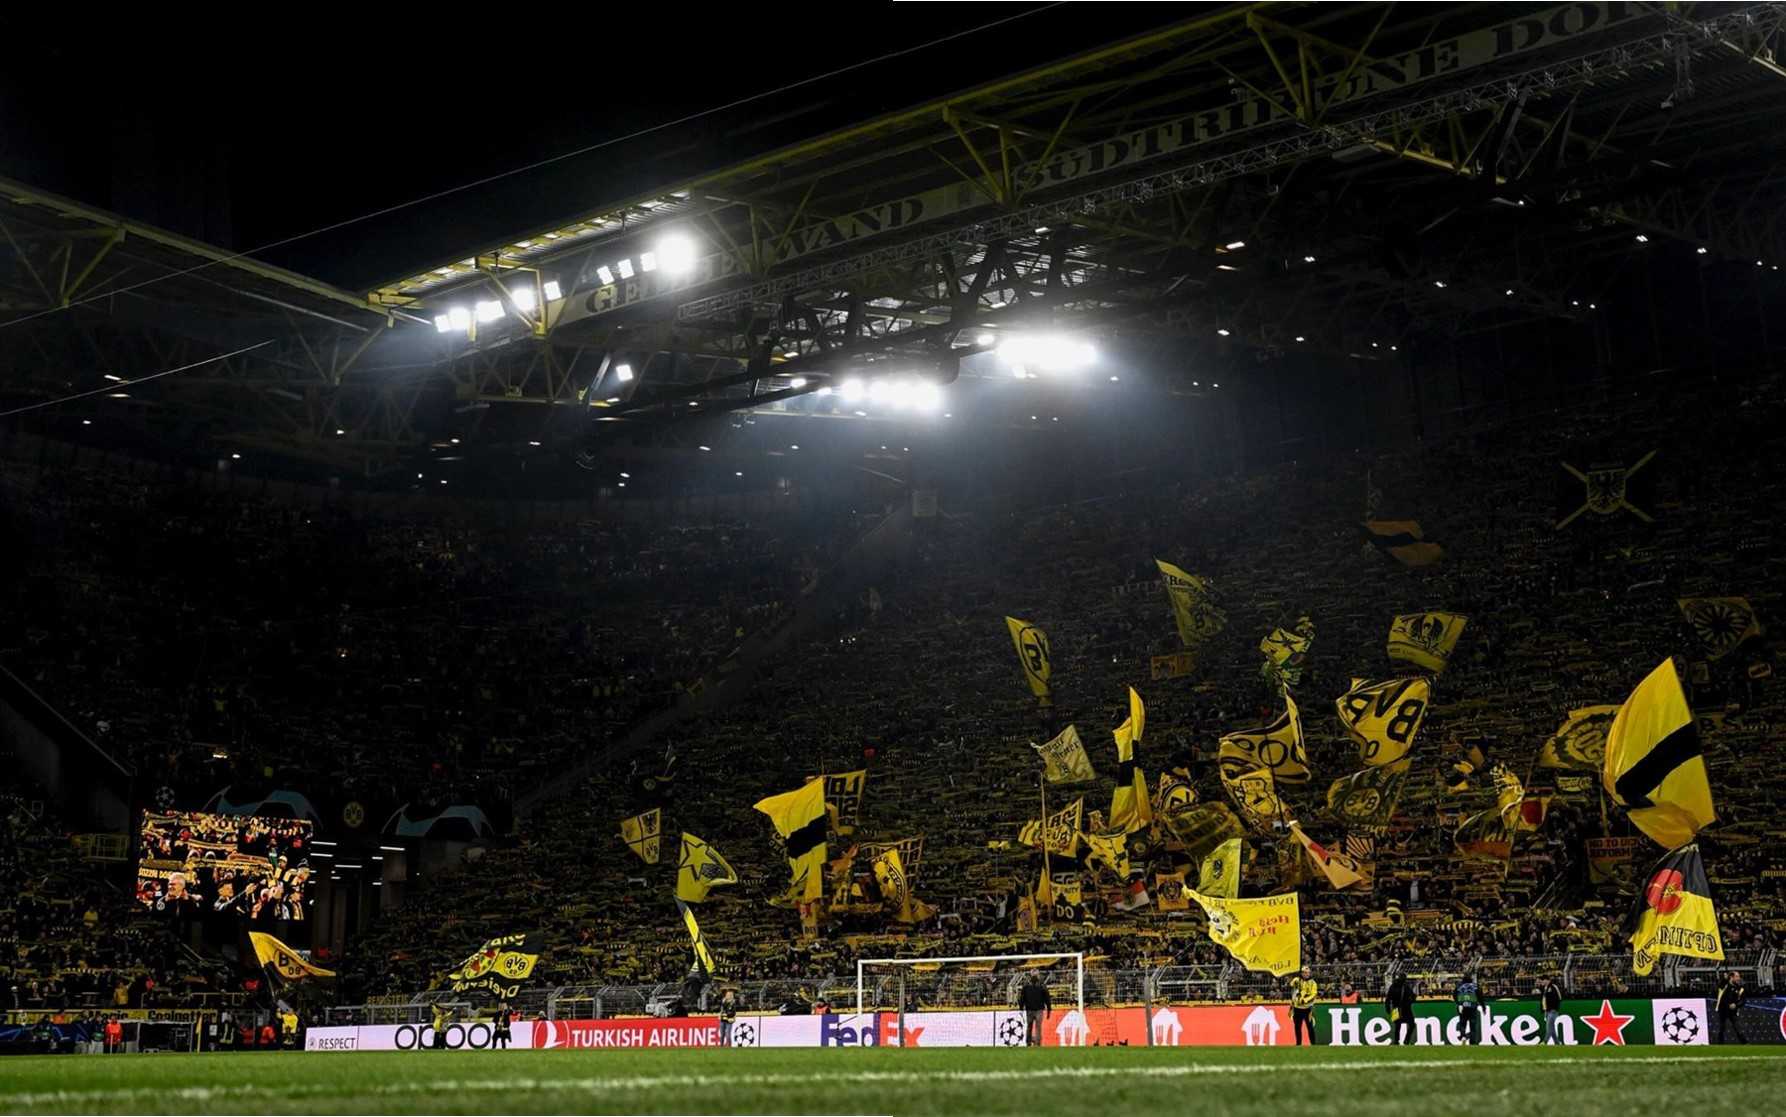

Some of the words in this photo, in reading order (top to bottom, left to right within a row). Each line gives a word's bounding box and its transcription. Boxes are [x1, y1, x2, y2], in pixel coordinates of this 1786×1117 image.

[571, 1029, 644, 1047] TURKISH
[821, 1012, 925, 1047] FedEx
[319, 1038, 356, 1049] RESPECT
